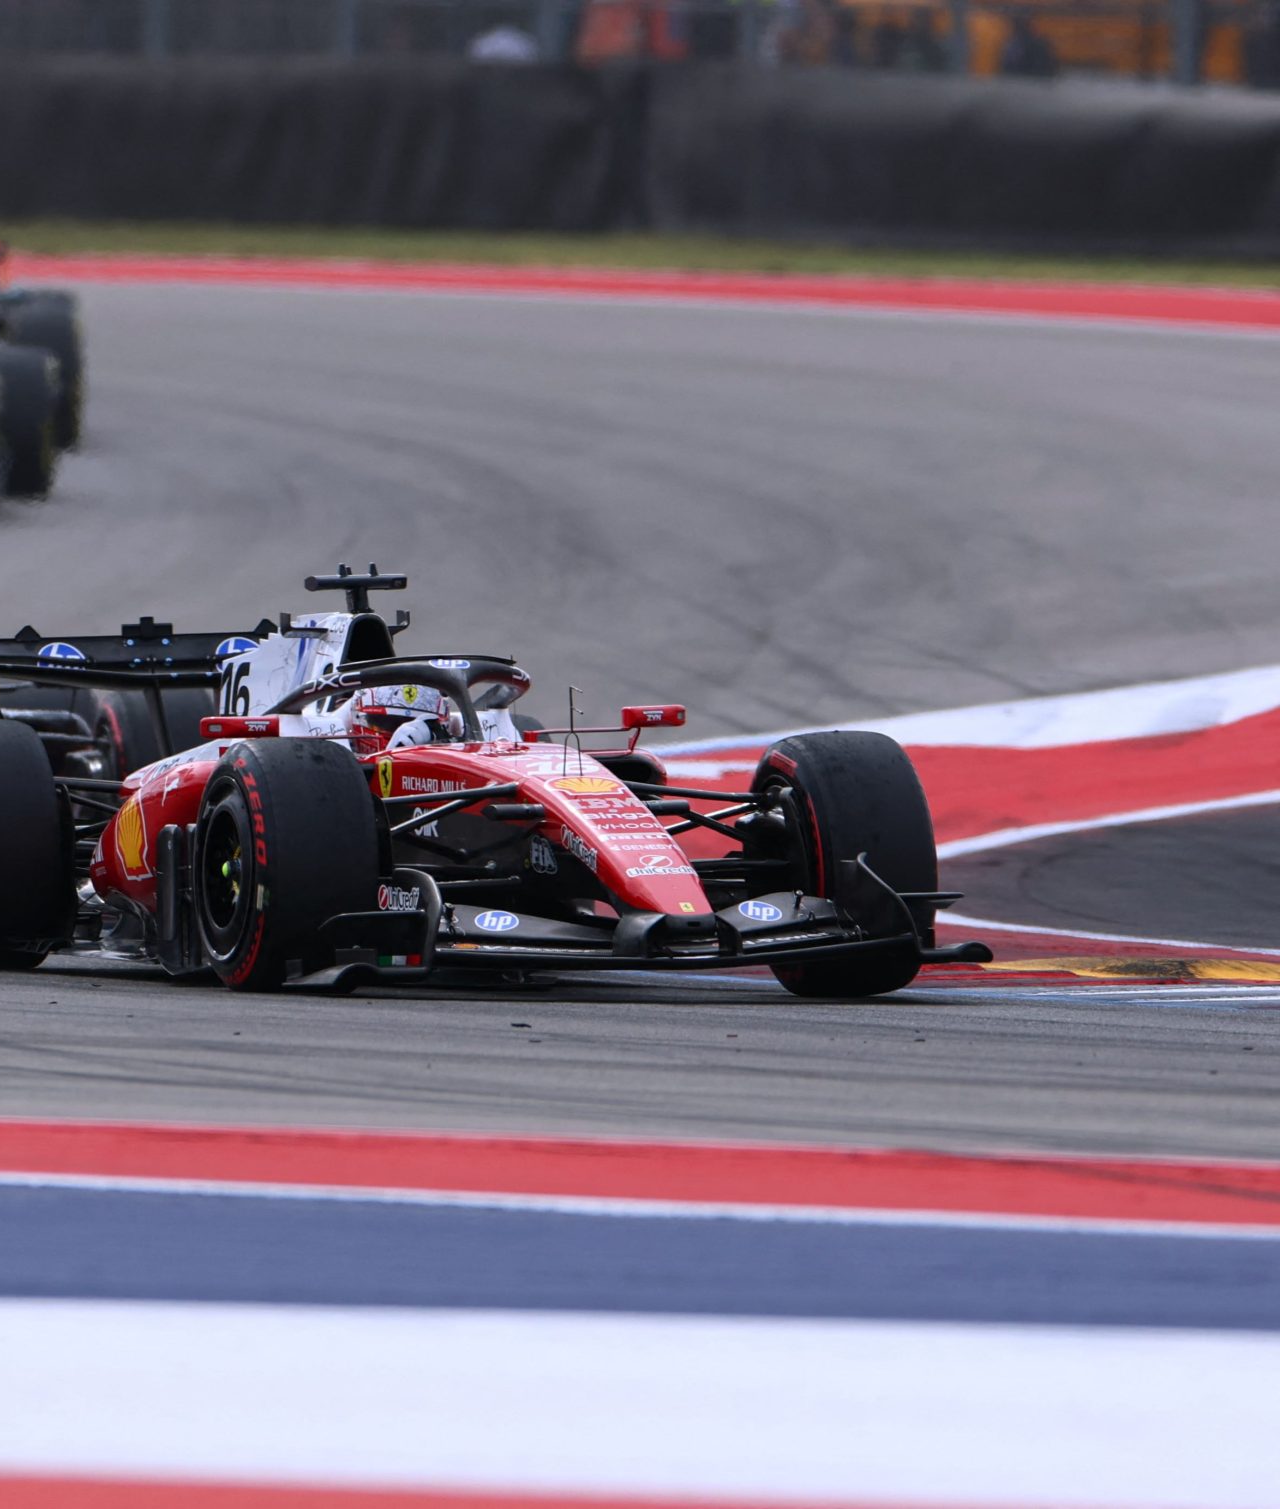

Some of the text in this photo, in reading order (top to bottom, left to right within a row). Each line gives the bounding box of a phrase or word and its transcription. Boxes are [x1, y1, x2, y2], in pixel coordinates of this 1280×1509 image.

[221, 661, 251, 716] 16
[525, 761, 600, 776] 16
[401, 775, 438, 793] RICHARD
[570, 797, 642, 810] IBM
[388, 886, 420, 911] UniCredit
[748, 901, 775, 921] hp
[483, 912, 514, 932] hp
